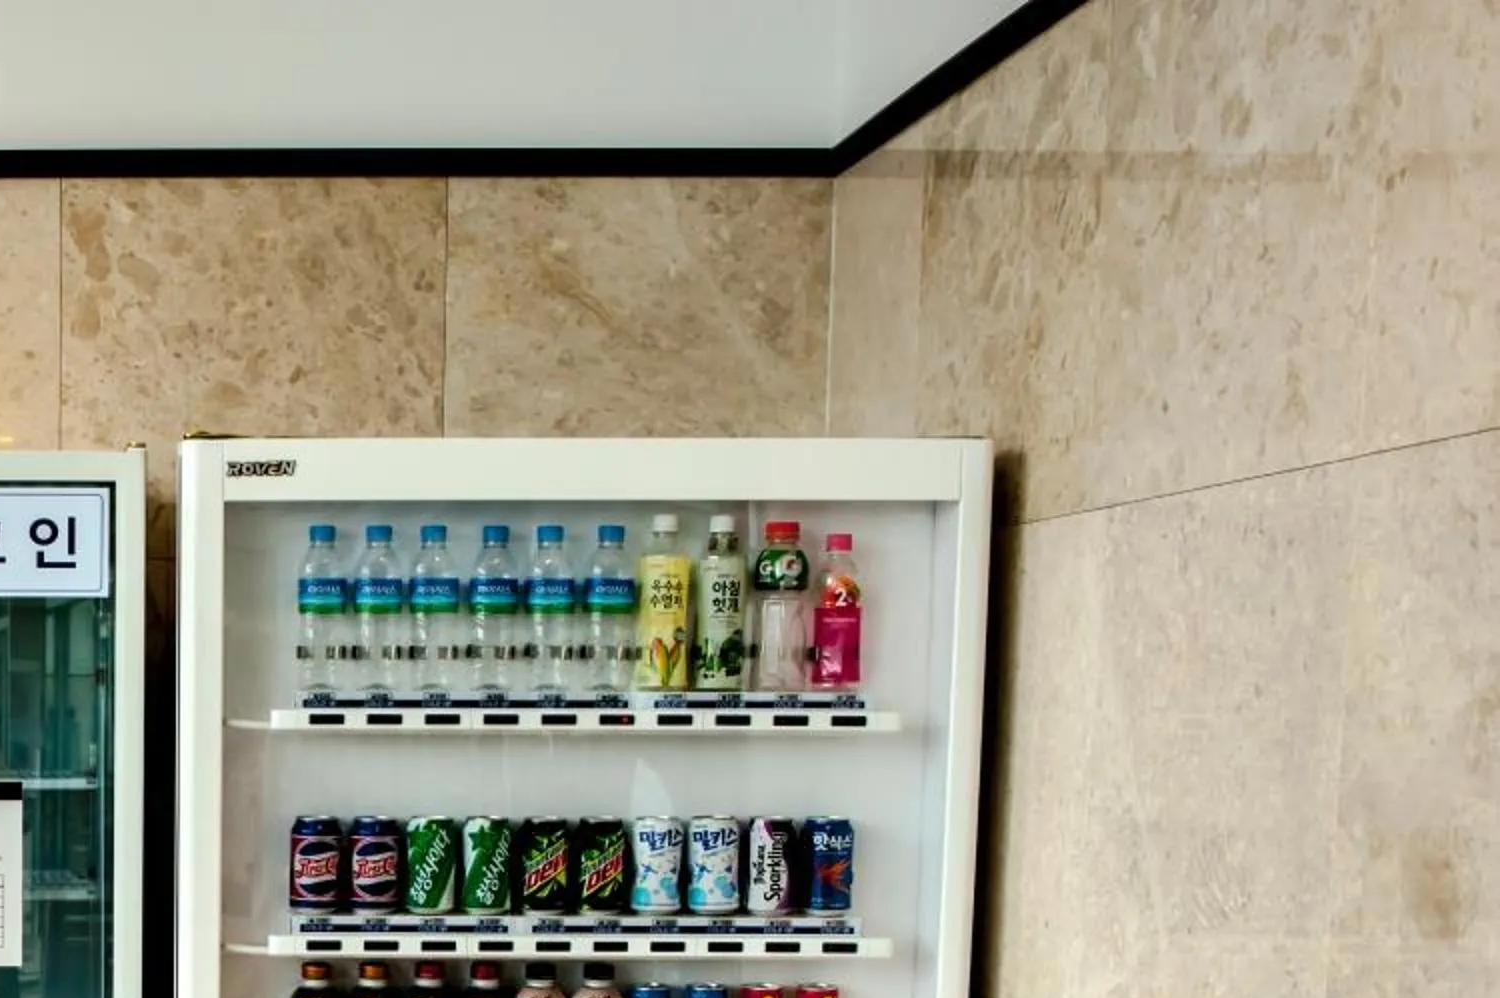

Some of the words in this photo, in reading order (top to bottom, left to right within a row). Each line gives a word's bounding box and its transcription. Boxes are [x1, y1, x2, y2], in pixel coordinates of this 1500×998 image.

[227, 460, 297, 477] ROVEN
[712, 580, 741, 596] 아침
[639, 828, 684, 852] 밀키스
[693, 827, 739, 852] 밀키스
